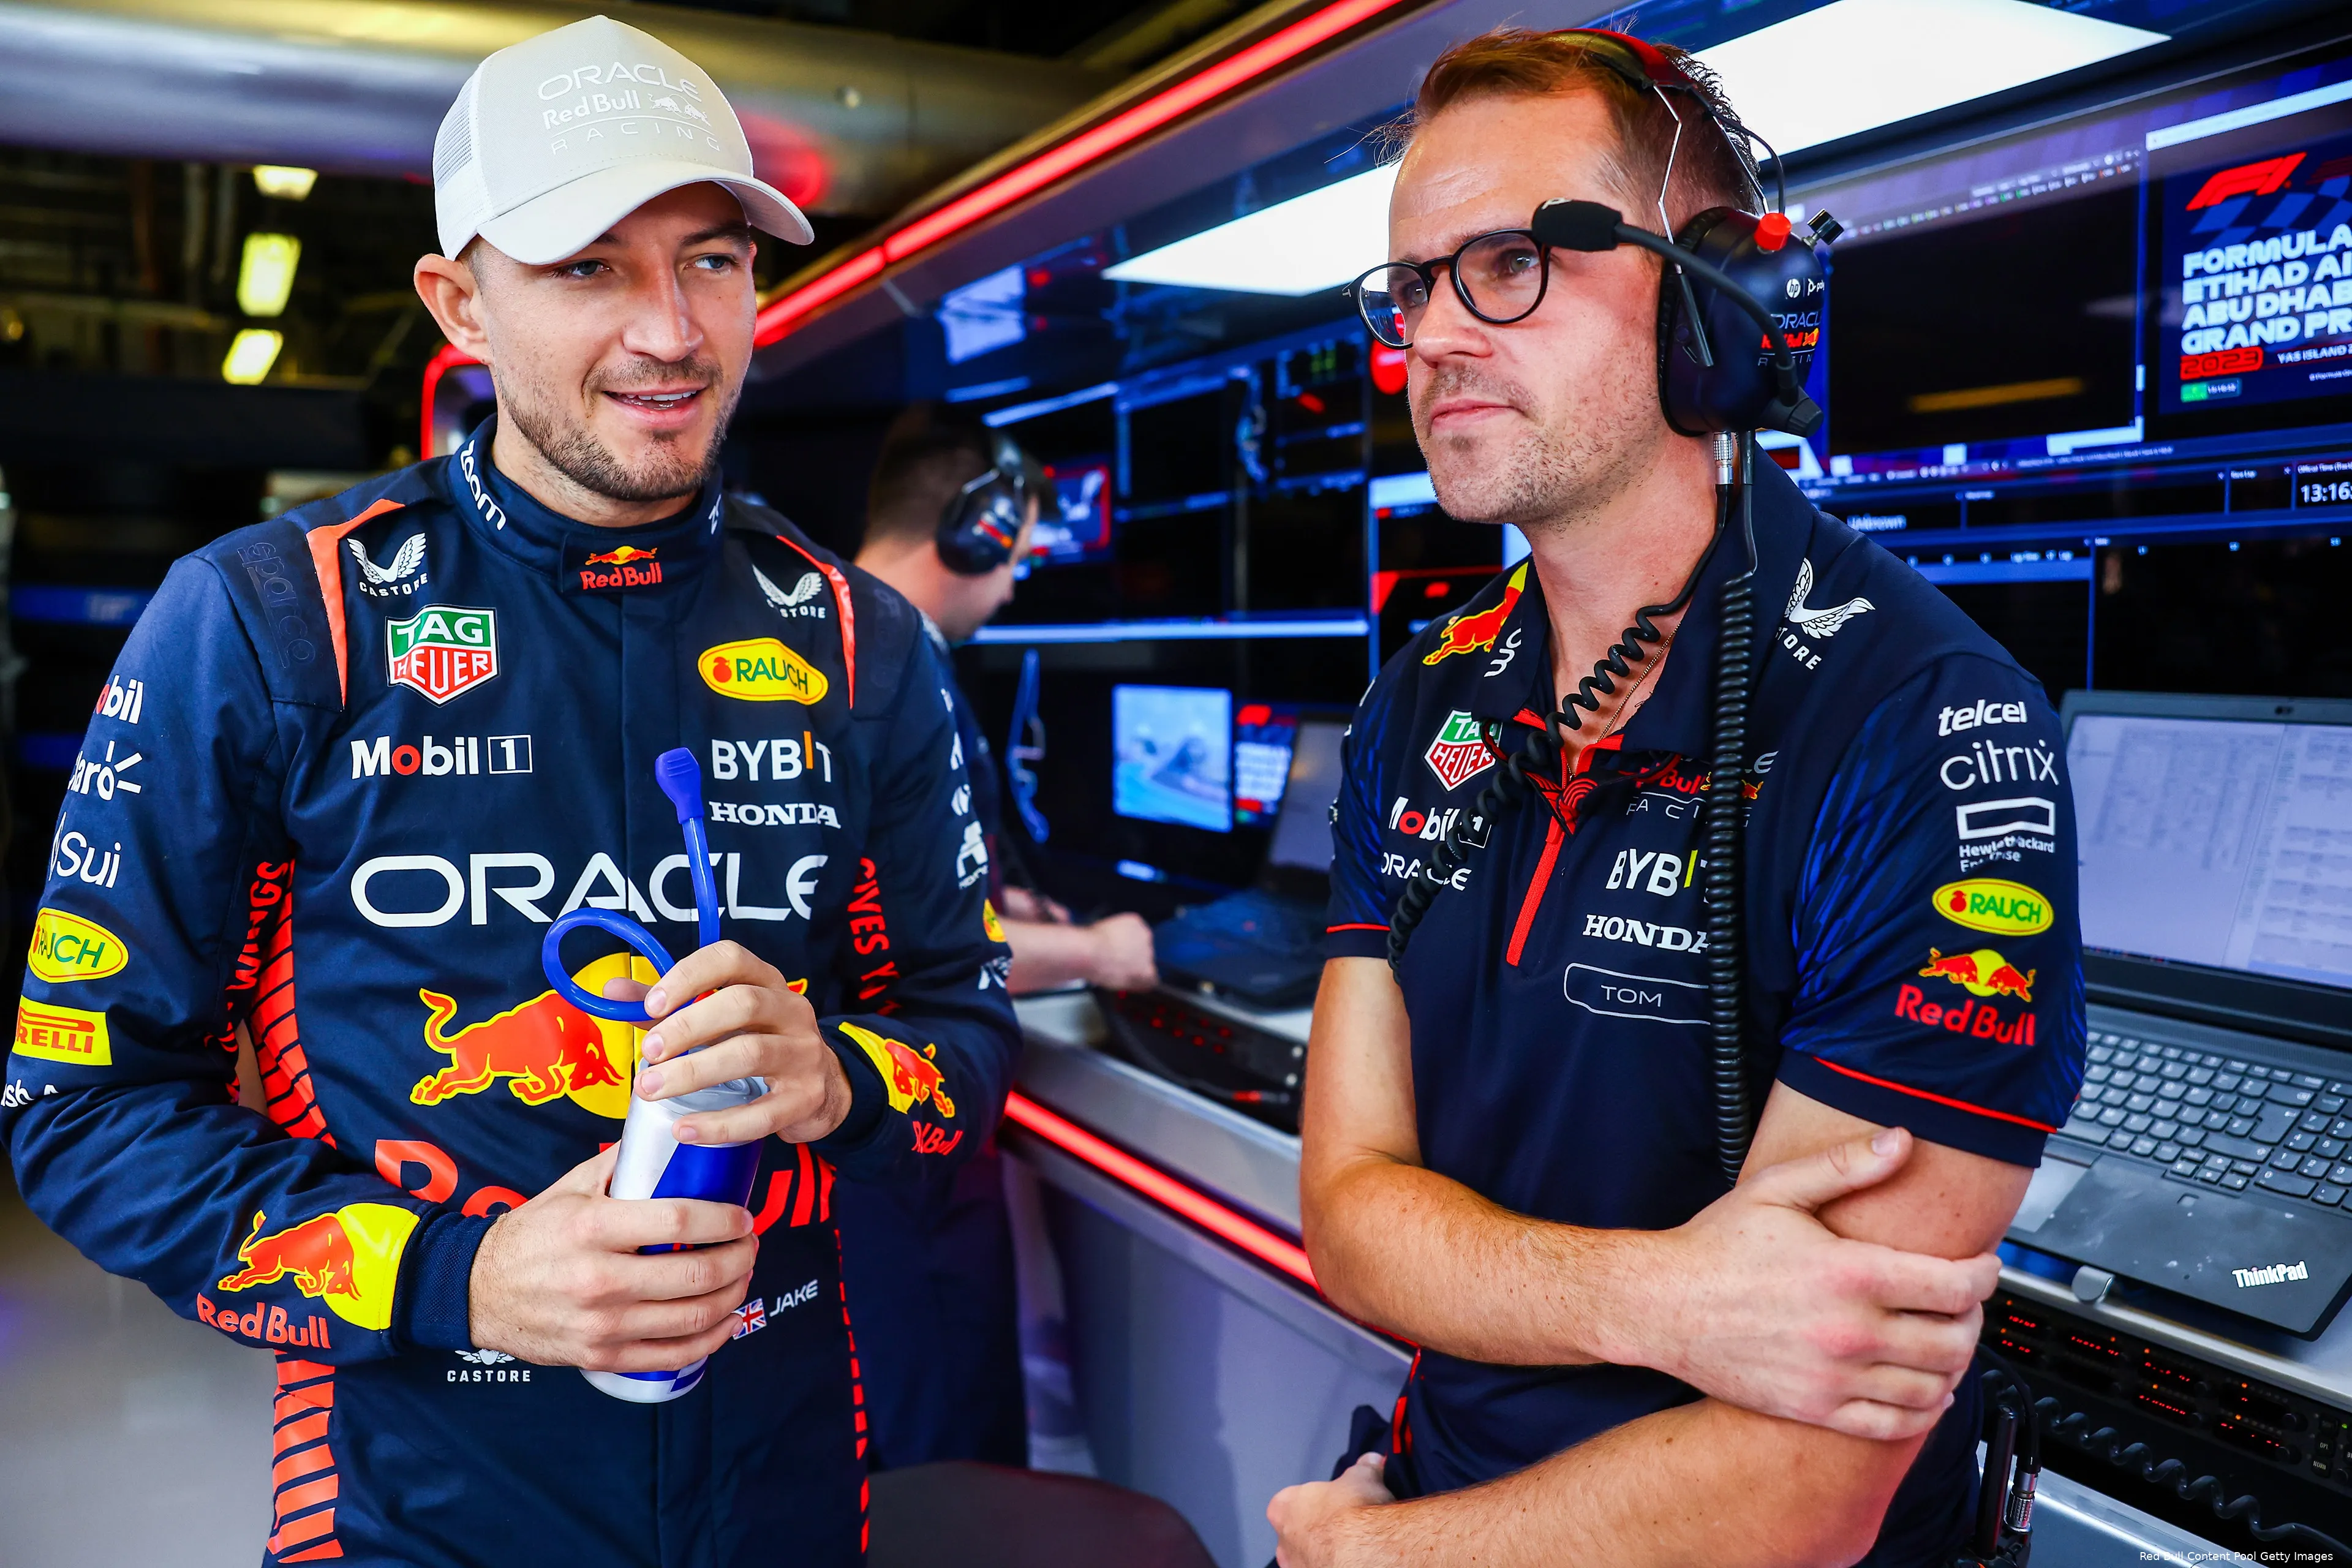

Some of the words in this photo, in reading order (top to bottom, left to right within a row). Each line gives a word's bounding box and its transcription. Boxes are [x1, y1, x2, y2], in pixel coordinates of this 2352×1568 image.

[538, 62, 701, 102] ORACLE
[541, 96, 592, 130] Red
[594, 89, 641, 113] Bull
[551, 122, 720, 156] RACING
[2183, 223, 2352, 279] FORMULA
[2182, 260, 2310, 305] ETIHAD
[2182, 295, 2253, 331] ABU
[2181, 315, 2301, 355] GRAND
[2277, 352, 2301, 364] YAS
[2302, 344, 2348, 361] ISLAND
[2182, 352, 2261, 376] 2023
[359, 573, 428, 597] CASTORE
[579, 567, 623, 590] Red
[623, 562, 663, 586] Bull
[396, 613, 484, 649] TAG
[397, 649, 489, 695] HEUER
[736, 657, 809, 695] RAUCH
[1939, 699, 2027, 736] telcel
[350, 736, 479, 780] Mobil
[712, 730, 831, 783] BYBIT
[1433, 745, 1493, 783] HEUER
[1940, 739, 2059, 790] citrix
[709, 801, 842, 829] HONDA
[2016, 835, 2056, 853] ackard
[350, 851, 829, 928] ORACLE
[1969, 892, 2042, 924] RAUCH
[1582, 914, 1711, 954] HONDA
[1600, 984, 1662, 1008] TOM
[1894, 984, 1974, 1033] Red
[1974, 1004, 2036, 1046] Bull
[2232, 1261, 2309, 1289] ThinkPad
[768, 1279, 819, 1317] JAKE
[197, 1292, 266, 1339] Red
[266, 1305, 331, 1349] Bull
[447, 1369, 531, 1382] CASTORE
